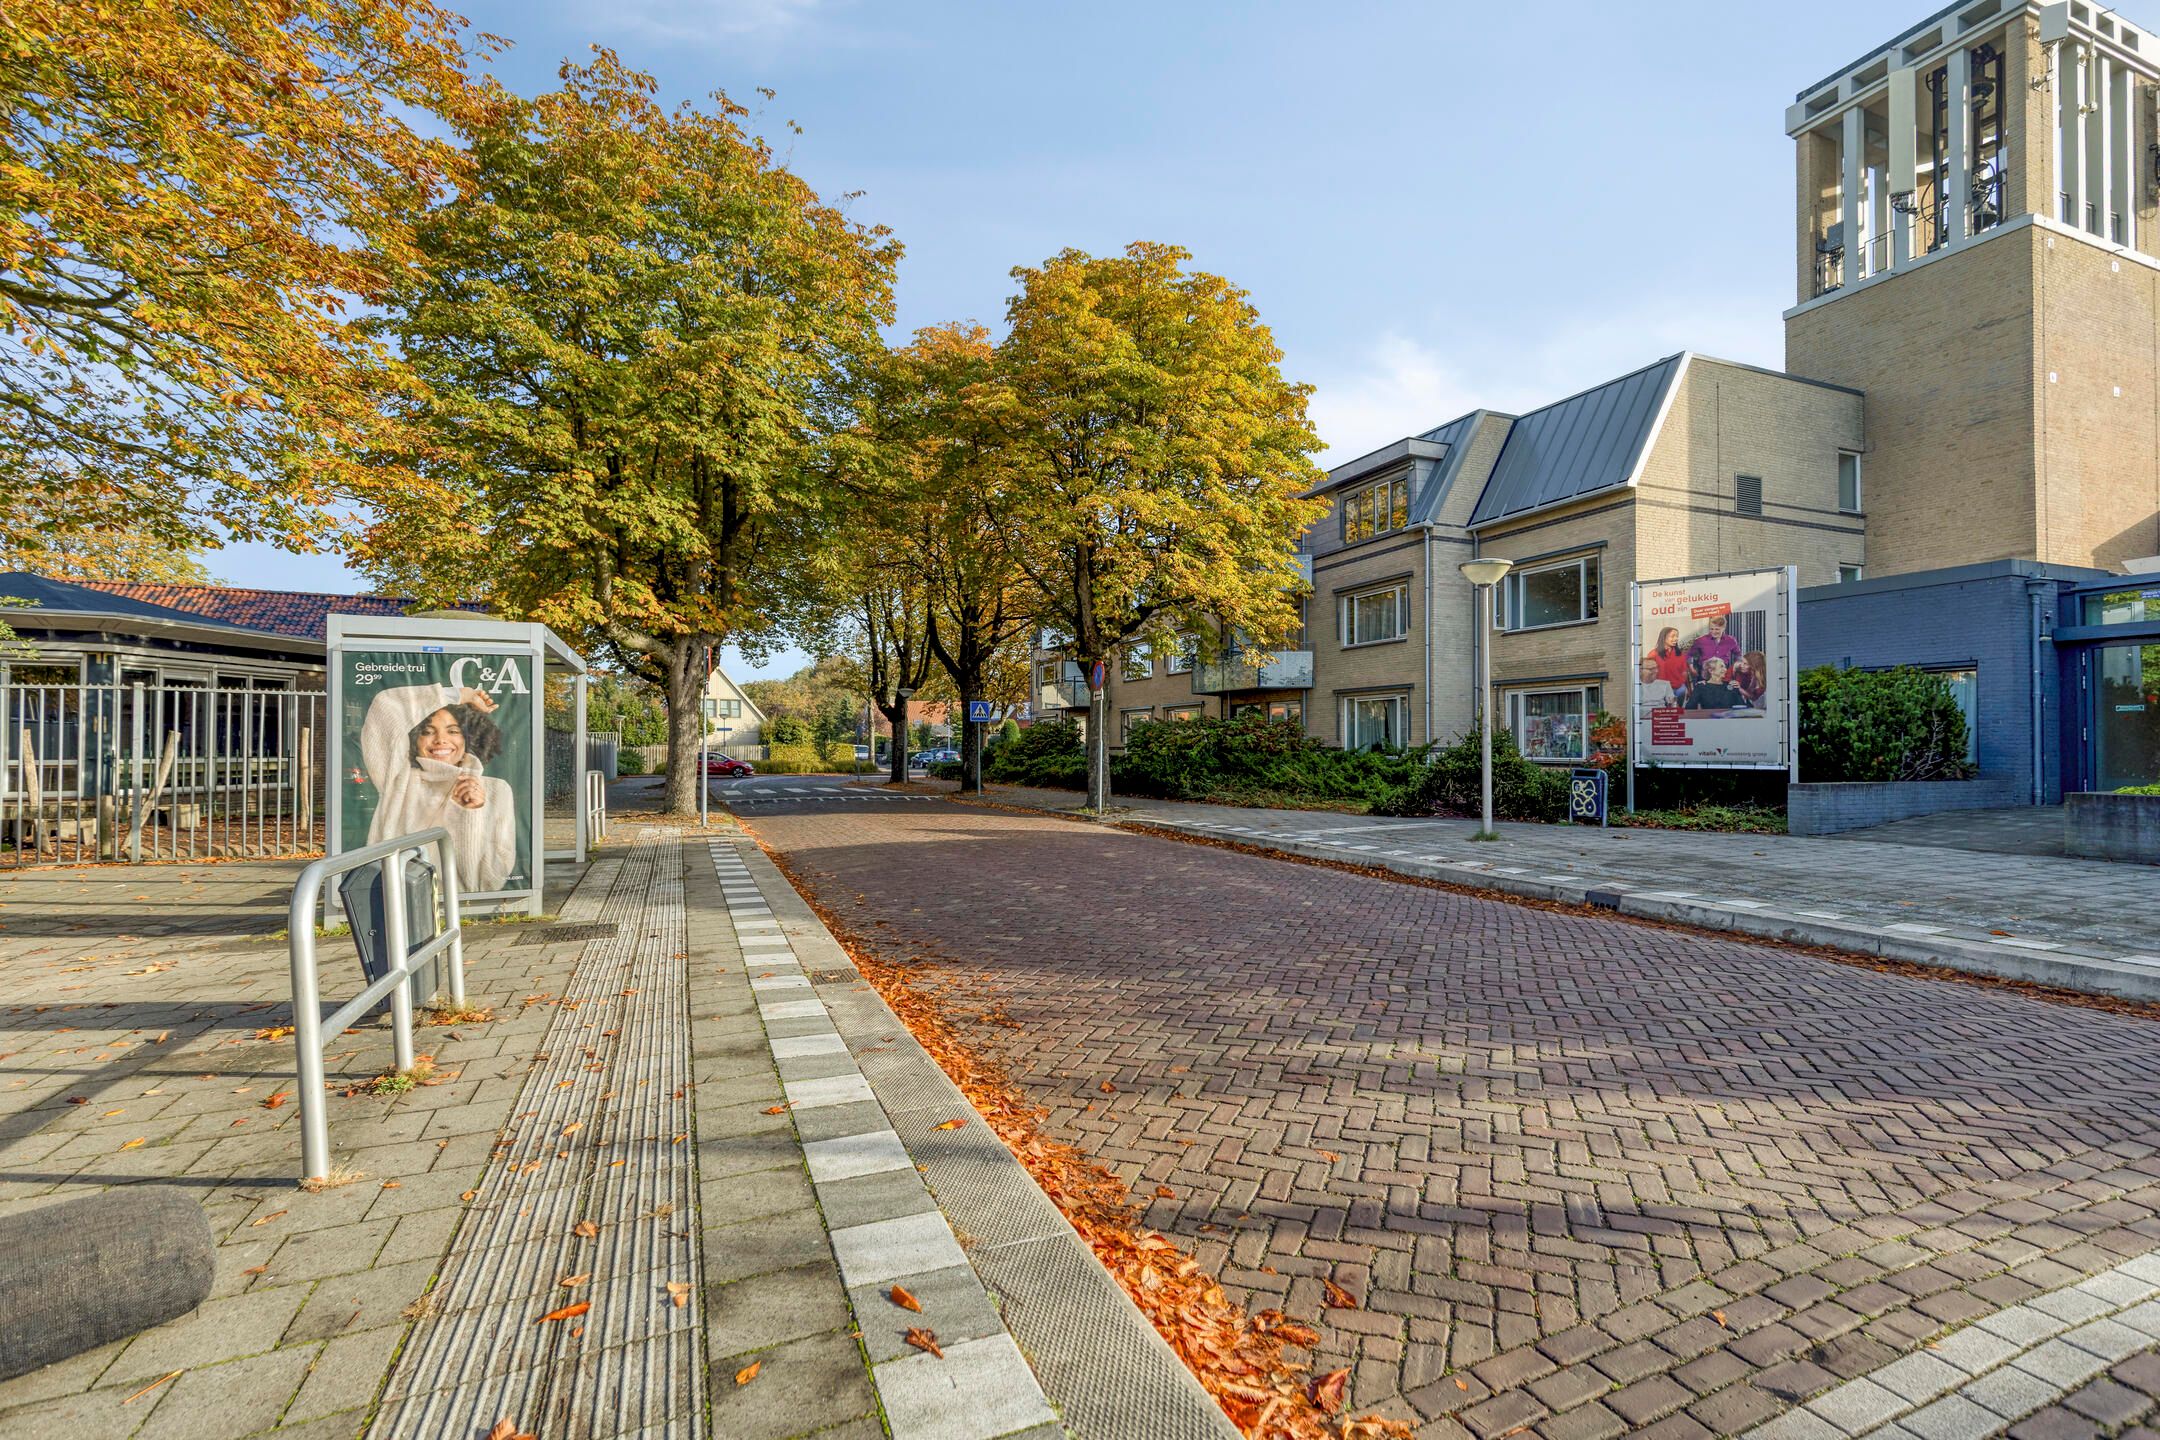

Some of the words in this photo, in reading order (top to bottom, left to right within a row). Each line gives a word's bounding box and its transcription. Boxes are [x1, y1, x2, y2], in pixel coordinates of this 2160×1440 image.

[1664, 589, 1686, 597] kunst
[1677, 593, 1718, 605] gelukkig
[1652, 604, 1675, 615] oud
[355, 662, 405, 672] Gebreide
[408, 664, 426, 672] trui
[449, 657, 530, 694] C&A
